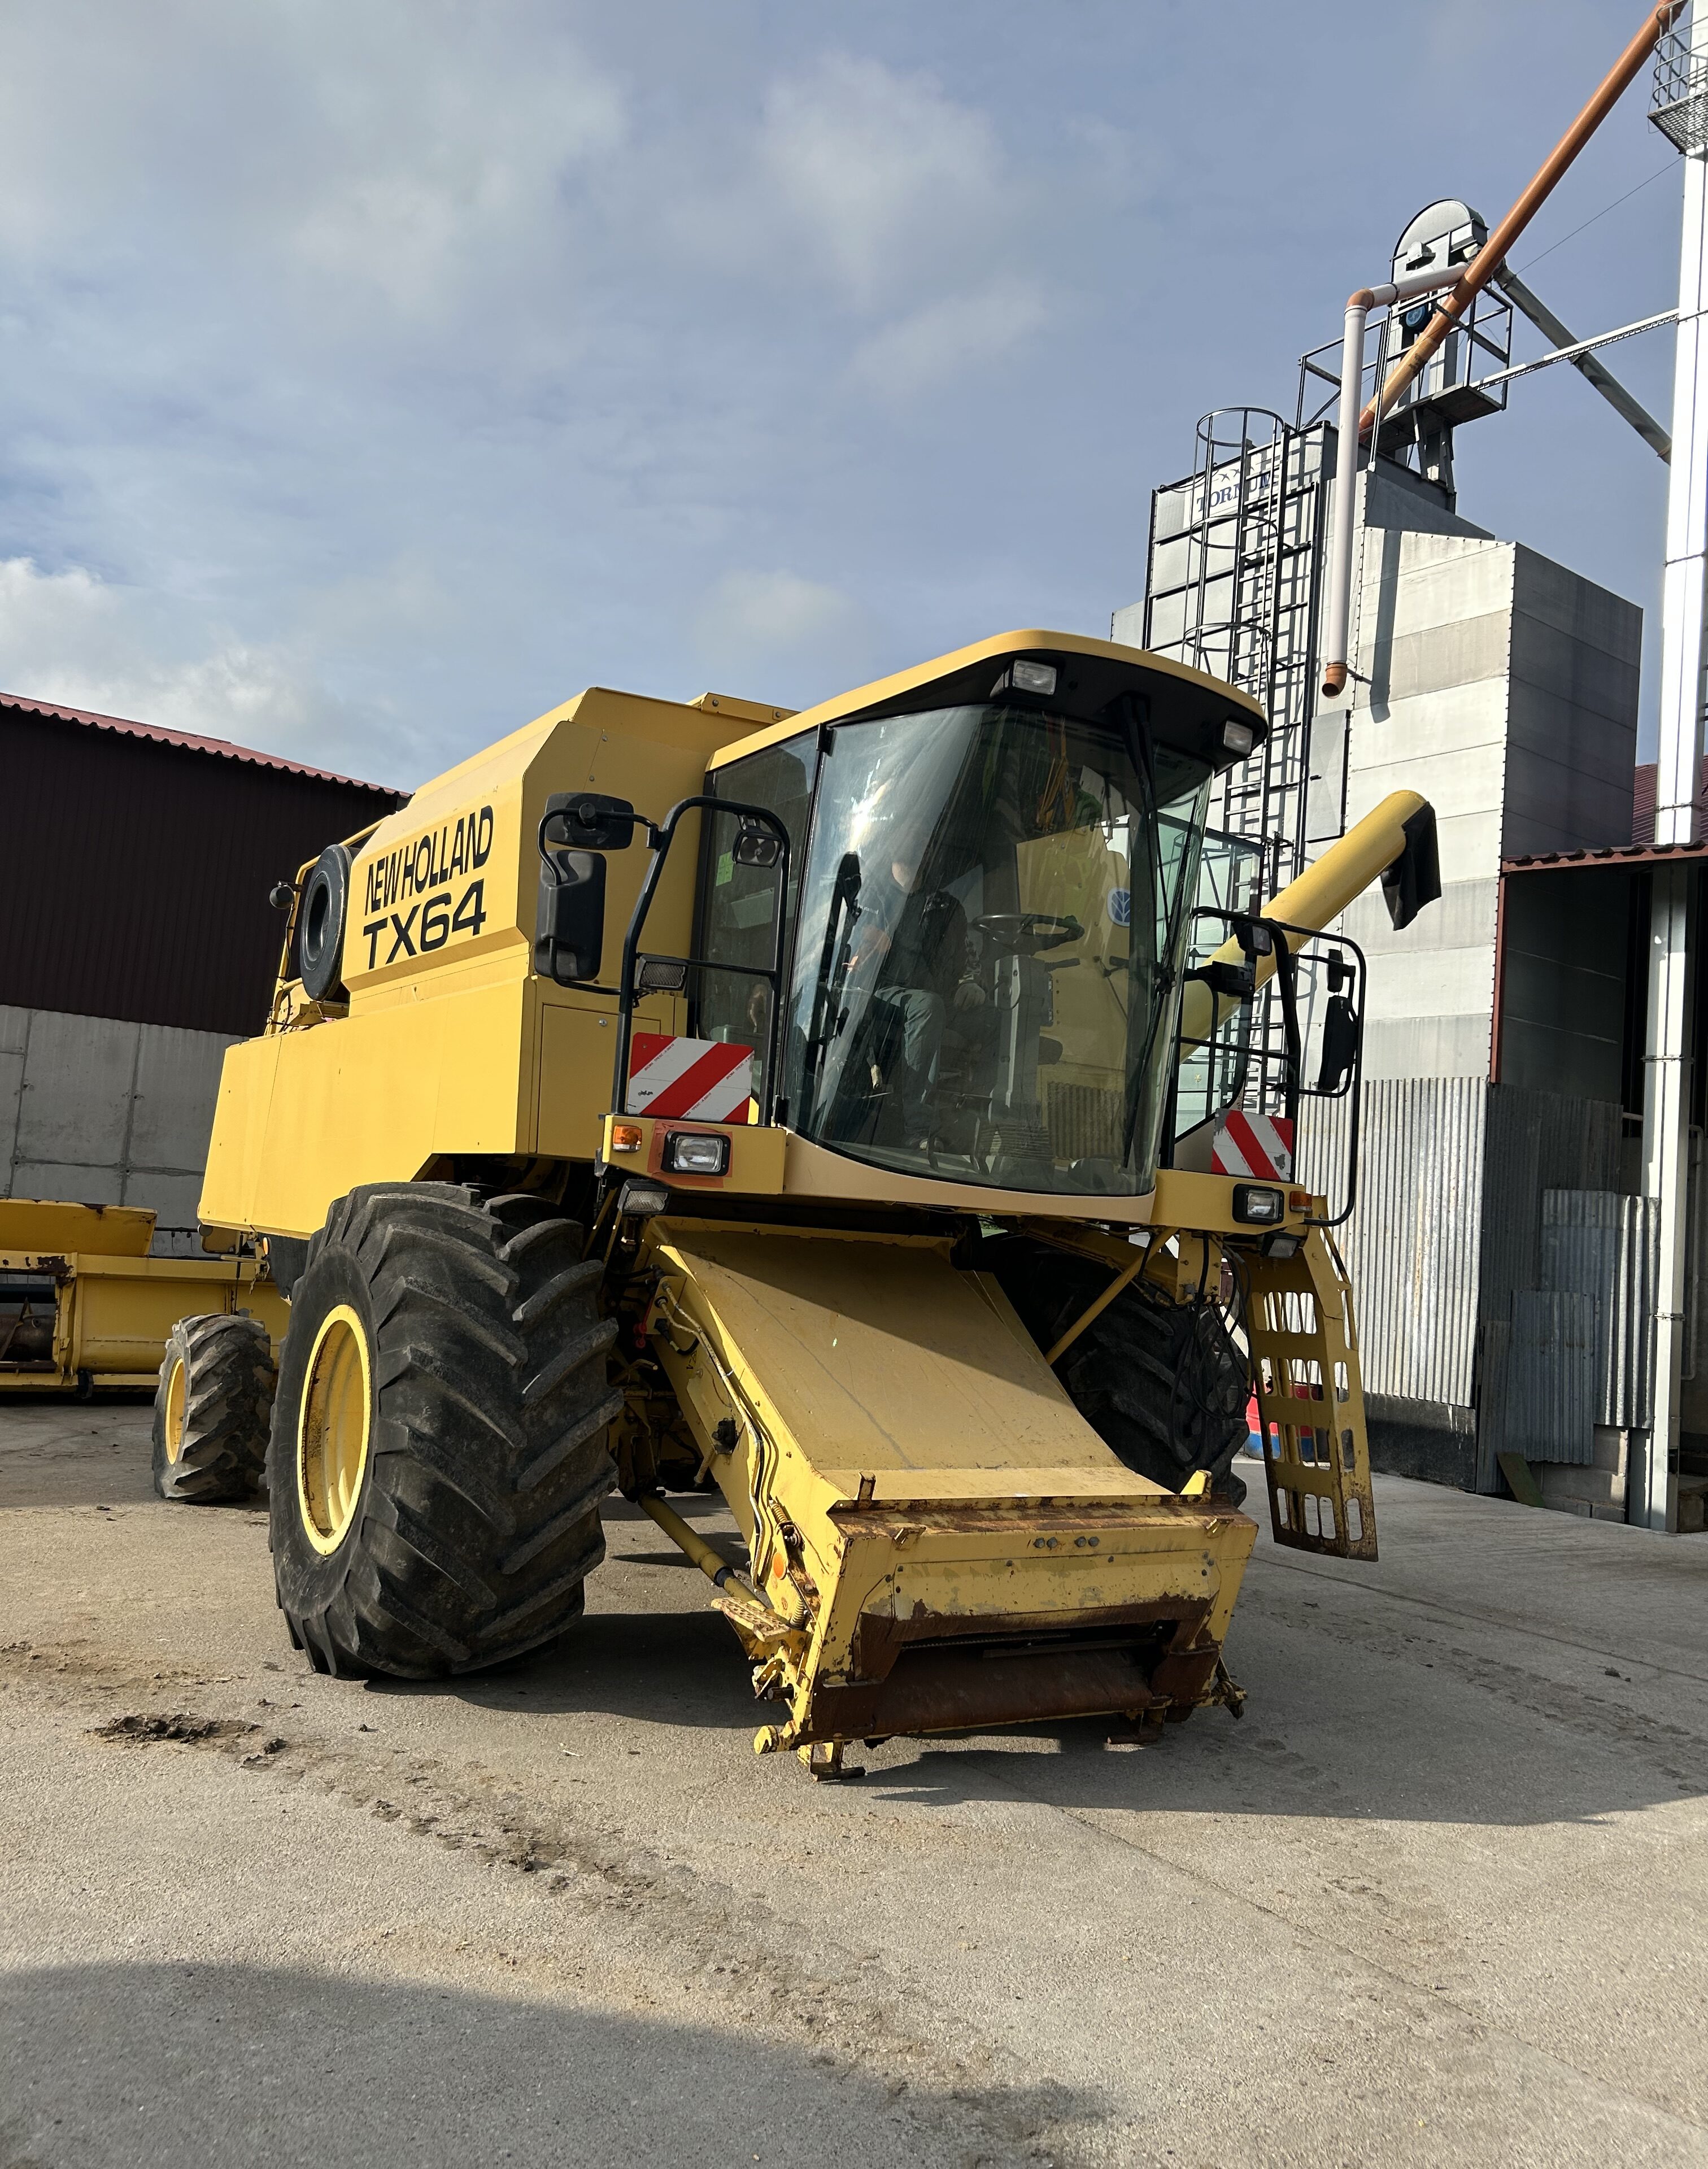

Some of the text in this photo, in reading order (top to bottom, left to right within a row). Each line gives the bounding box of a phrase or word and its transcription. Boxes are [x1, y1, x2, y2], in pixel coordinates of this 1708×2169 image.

[365, 805, 493, 916] NEW HOLLAND
[363, 878, 486, 970] TX64
